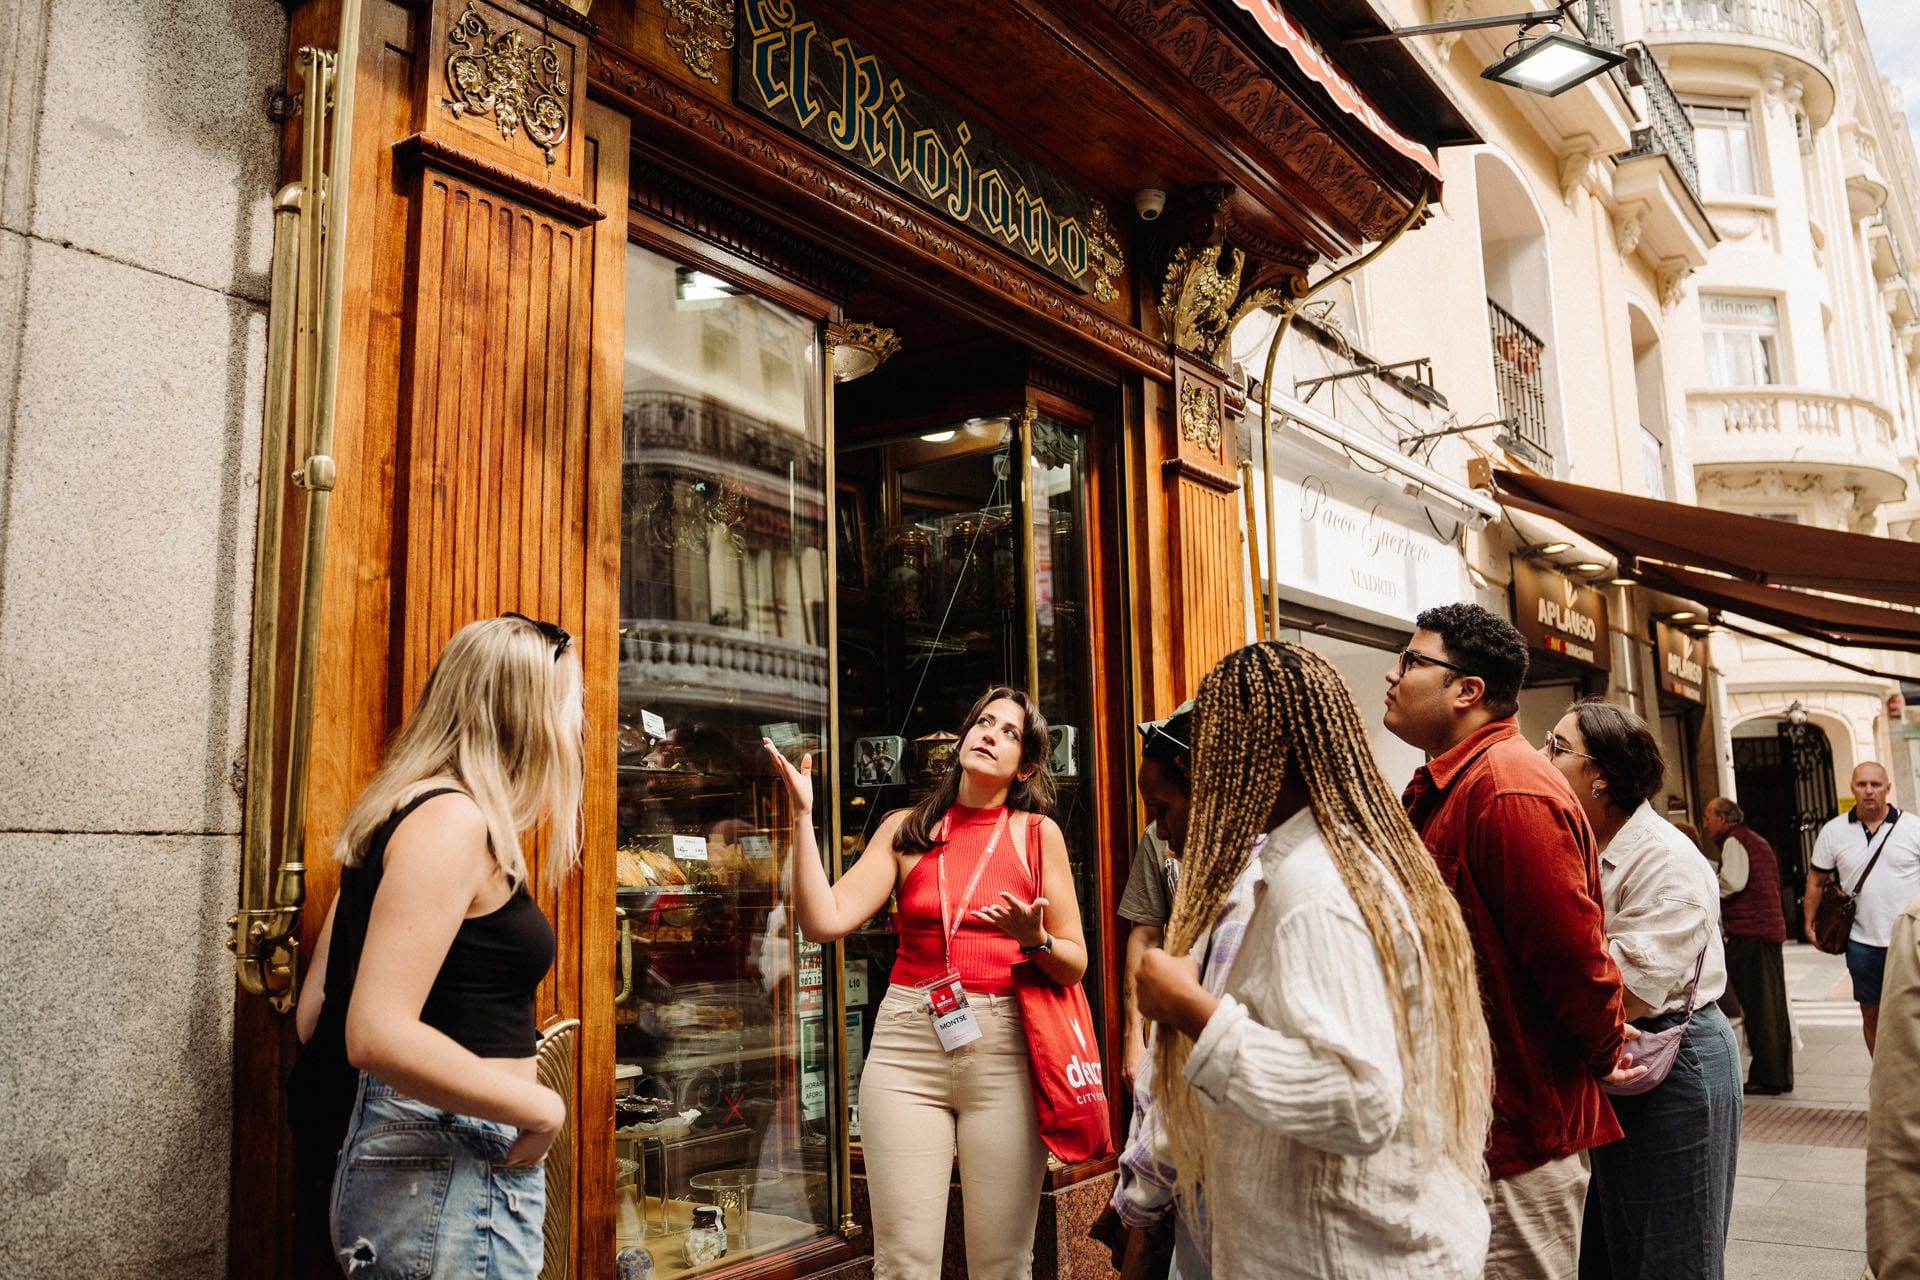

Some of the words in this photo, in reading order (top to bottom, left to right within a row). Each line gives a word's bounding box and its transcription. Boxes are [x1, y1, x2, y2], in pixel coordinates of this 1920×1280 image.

[744, 0, 821, 129] El
[827, 38, 1088, 280] Riojano
[1301, 475, 1356, 532] Paco
[1362, 496, 1431, 562] Guerrero
[1351, 569, 1398, 599] MADRID
[1537, 597, 1597, 643] APLAUSO
[1667, 652, 1703, 685] APLAUSO
[849, 979, 860, 988] L10
[939, 1014, 967, 1031] MONTSE
